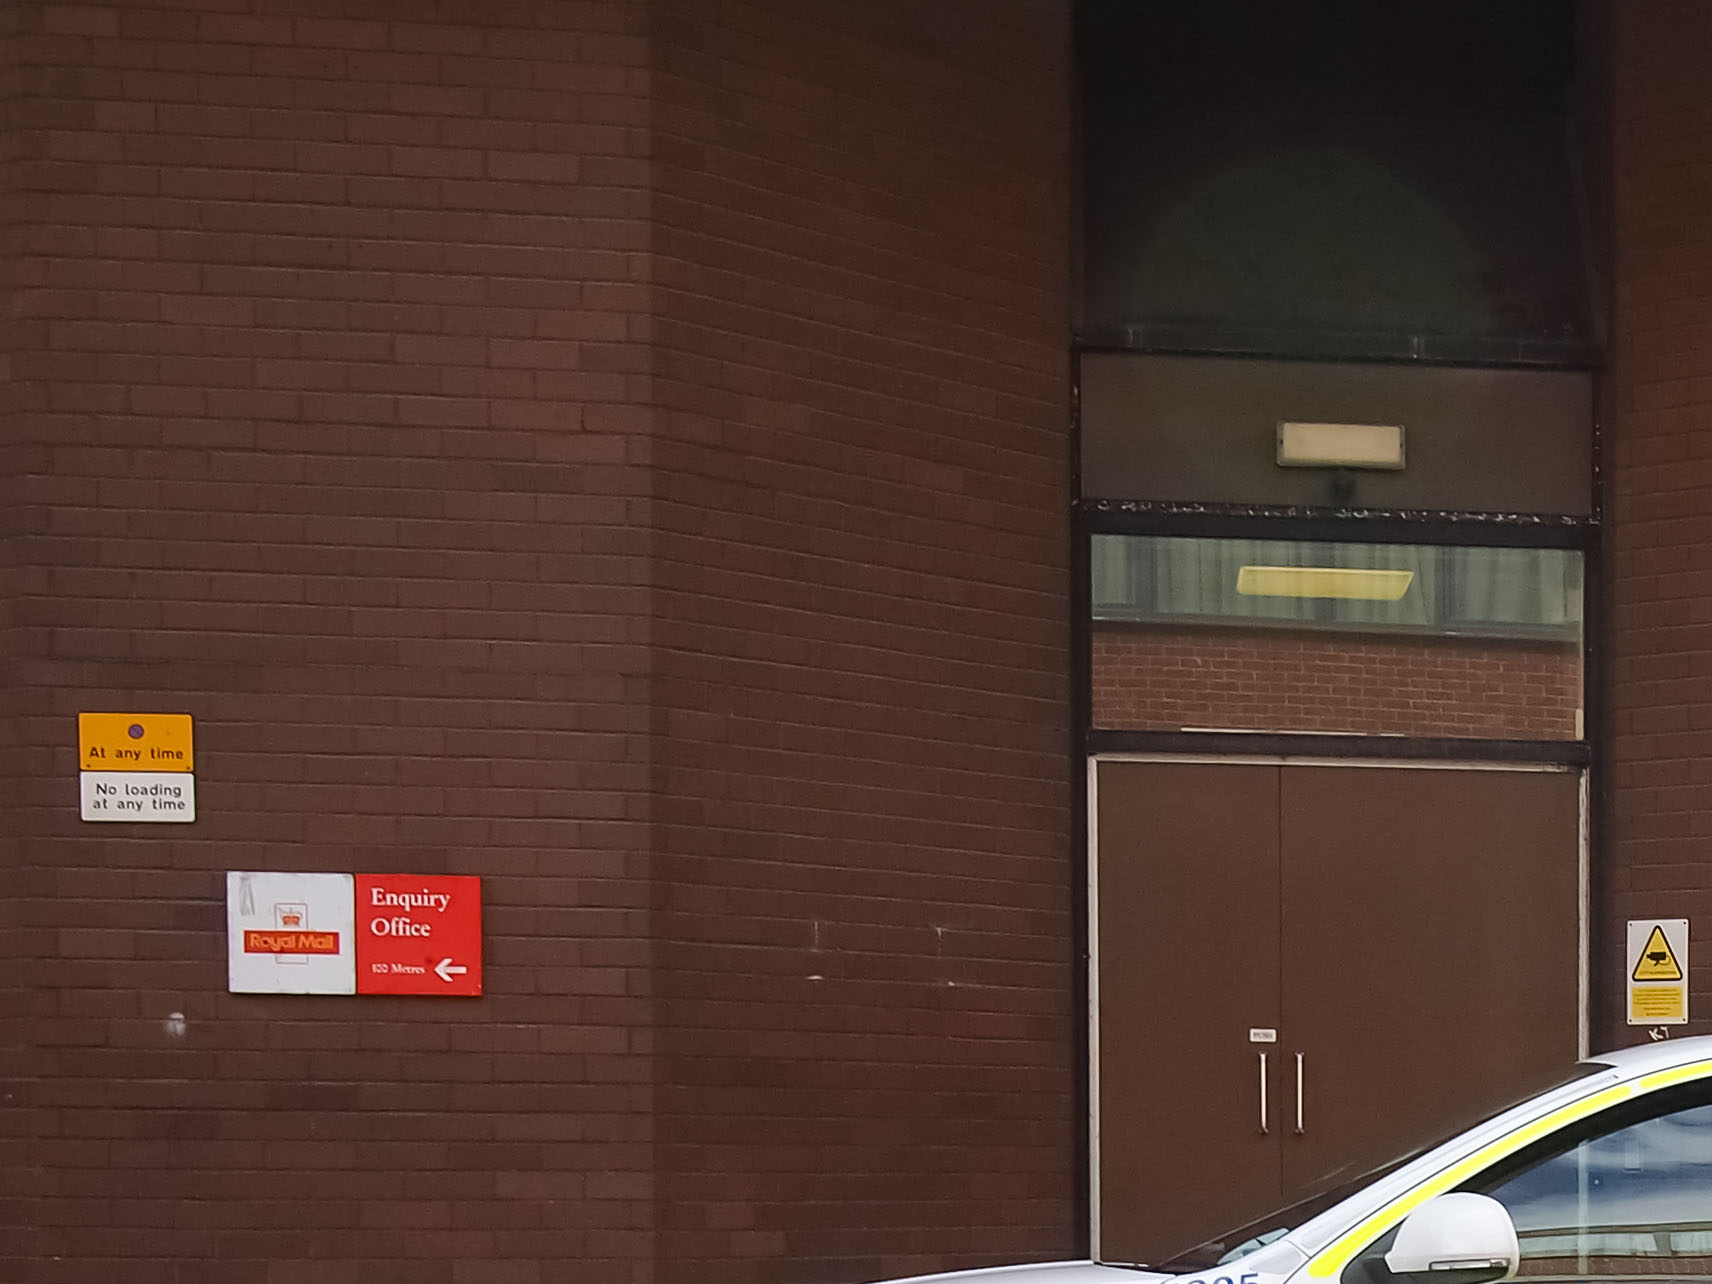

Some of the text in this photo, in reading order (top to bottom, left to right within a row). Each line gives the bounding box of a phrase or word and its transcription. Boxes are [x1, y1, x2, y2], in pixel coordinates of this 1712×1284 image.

[89, 747, 184, 760] At any time
[96, 784, 182, 798] No loading
[93, 799, 186, 812] at any time
[371, 888, 451, 912] Enquiry
[370, 917, 431, 936] Office
[250, 933, 334, 951] Royal Mail
